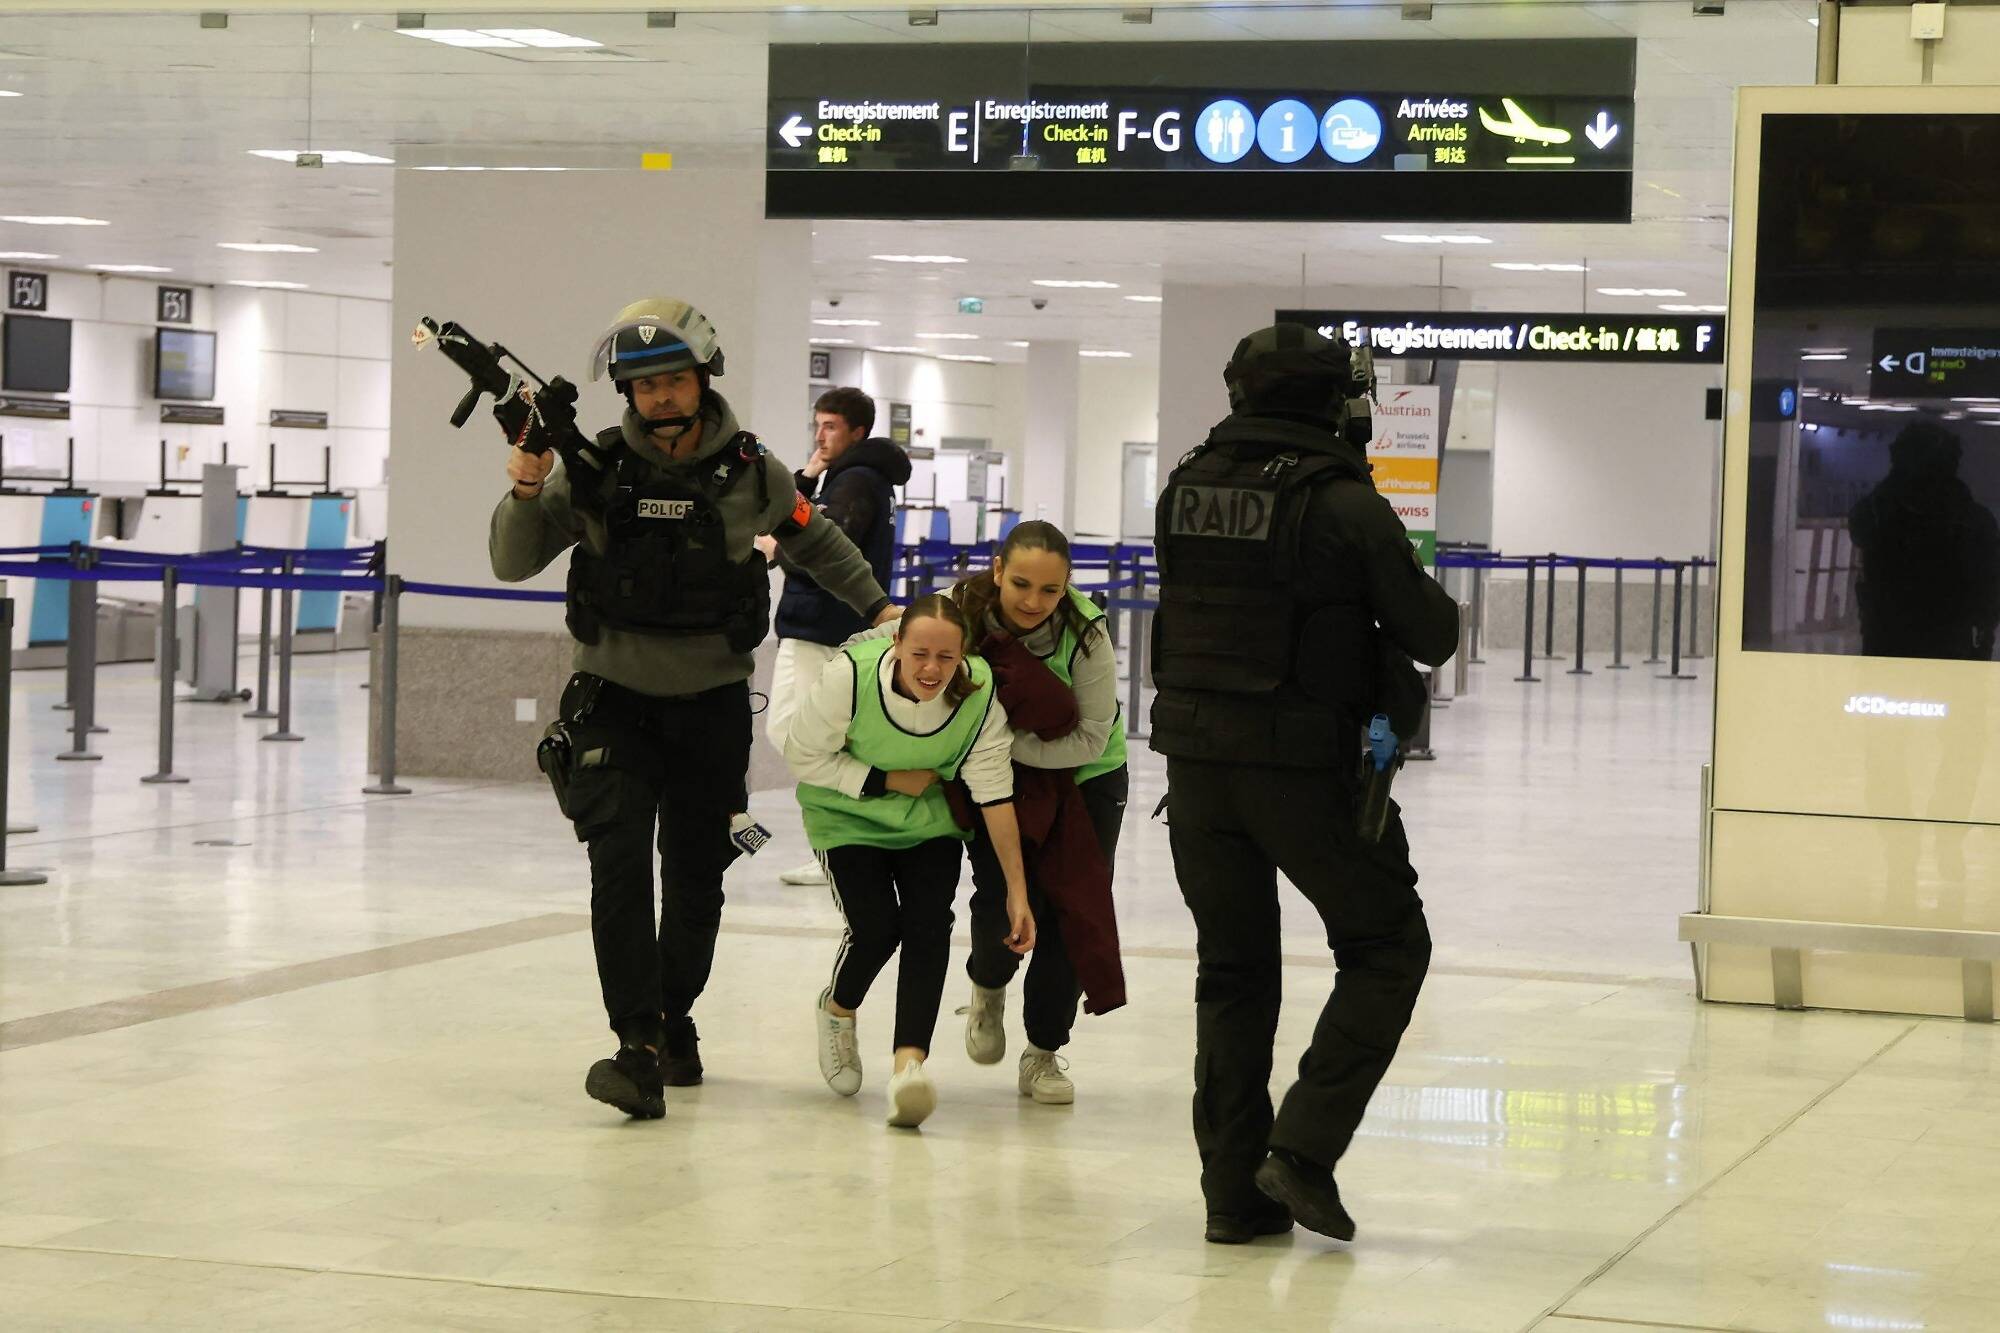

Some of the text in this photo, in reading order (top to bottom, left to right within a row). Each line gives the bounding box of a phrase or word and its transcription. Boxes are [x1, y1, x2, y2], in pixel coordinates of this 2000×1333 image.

[818, 100, 940, 124] Enregistrement
[984, 100, 1109, 124] Enregistrement
[1396, 98, 1469, 119] Arrivées
[818, 123, 881, 142] Check-in
[948, 112, 969, 152] E
[1043, 123, 1109, 142] Check-in
[1117, 111, 1181, 152] F-G
[1407, 122, 1468, 142] Arrivals
[817, 146, 849, 163] 值机
[1076, 147, 1107, 164] 值机
[1434, 146, 1466, 164] 到达
[1528, 324, 1620, 351] Check-in
[1696, 325, 1712, 353] F
[1374, 403, 1431, 417] Austrian
[1177, 487, 1265, 537] RAID
[1843, 695, 1946, 718] JCDecaux
